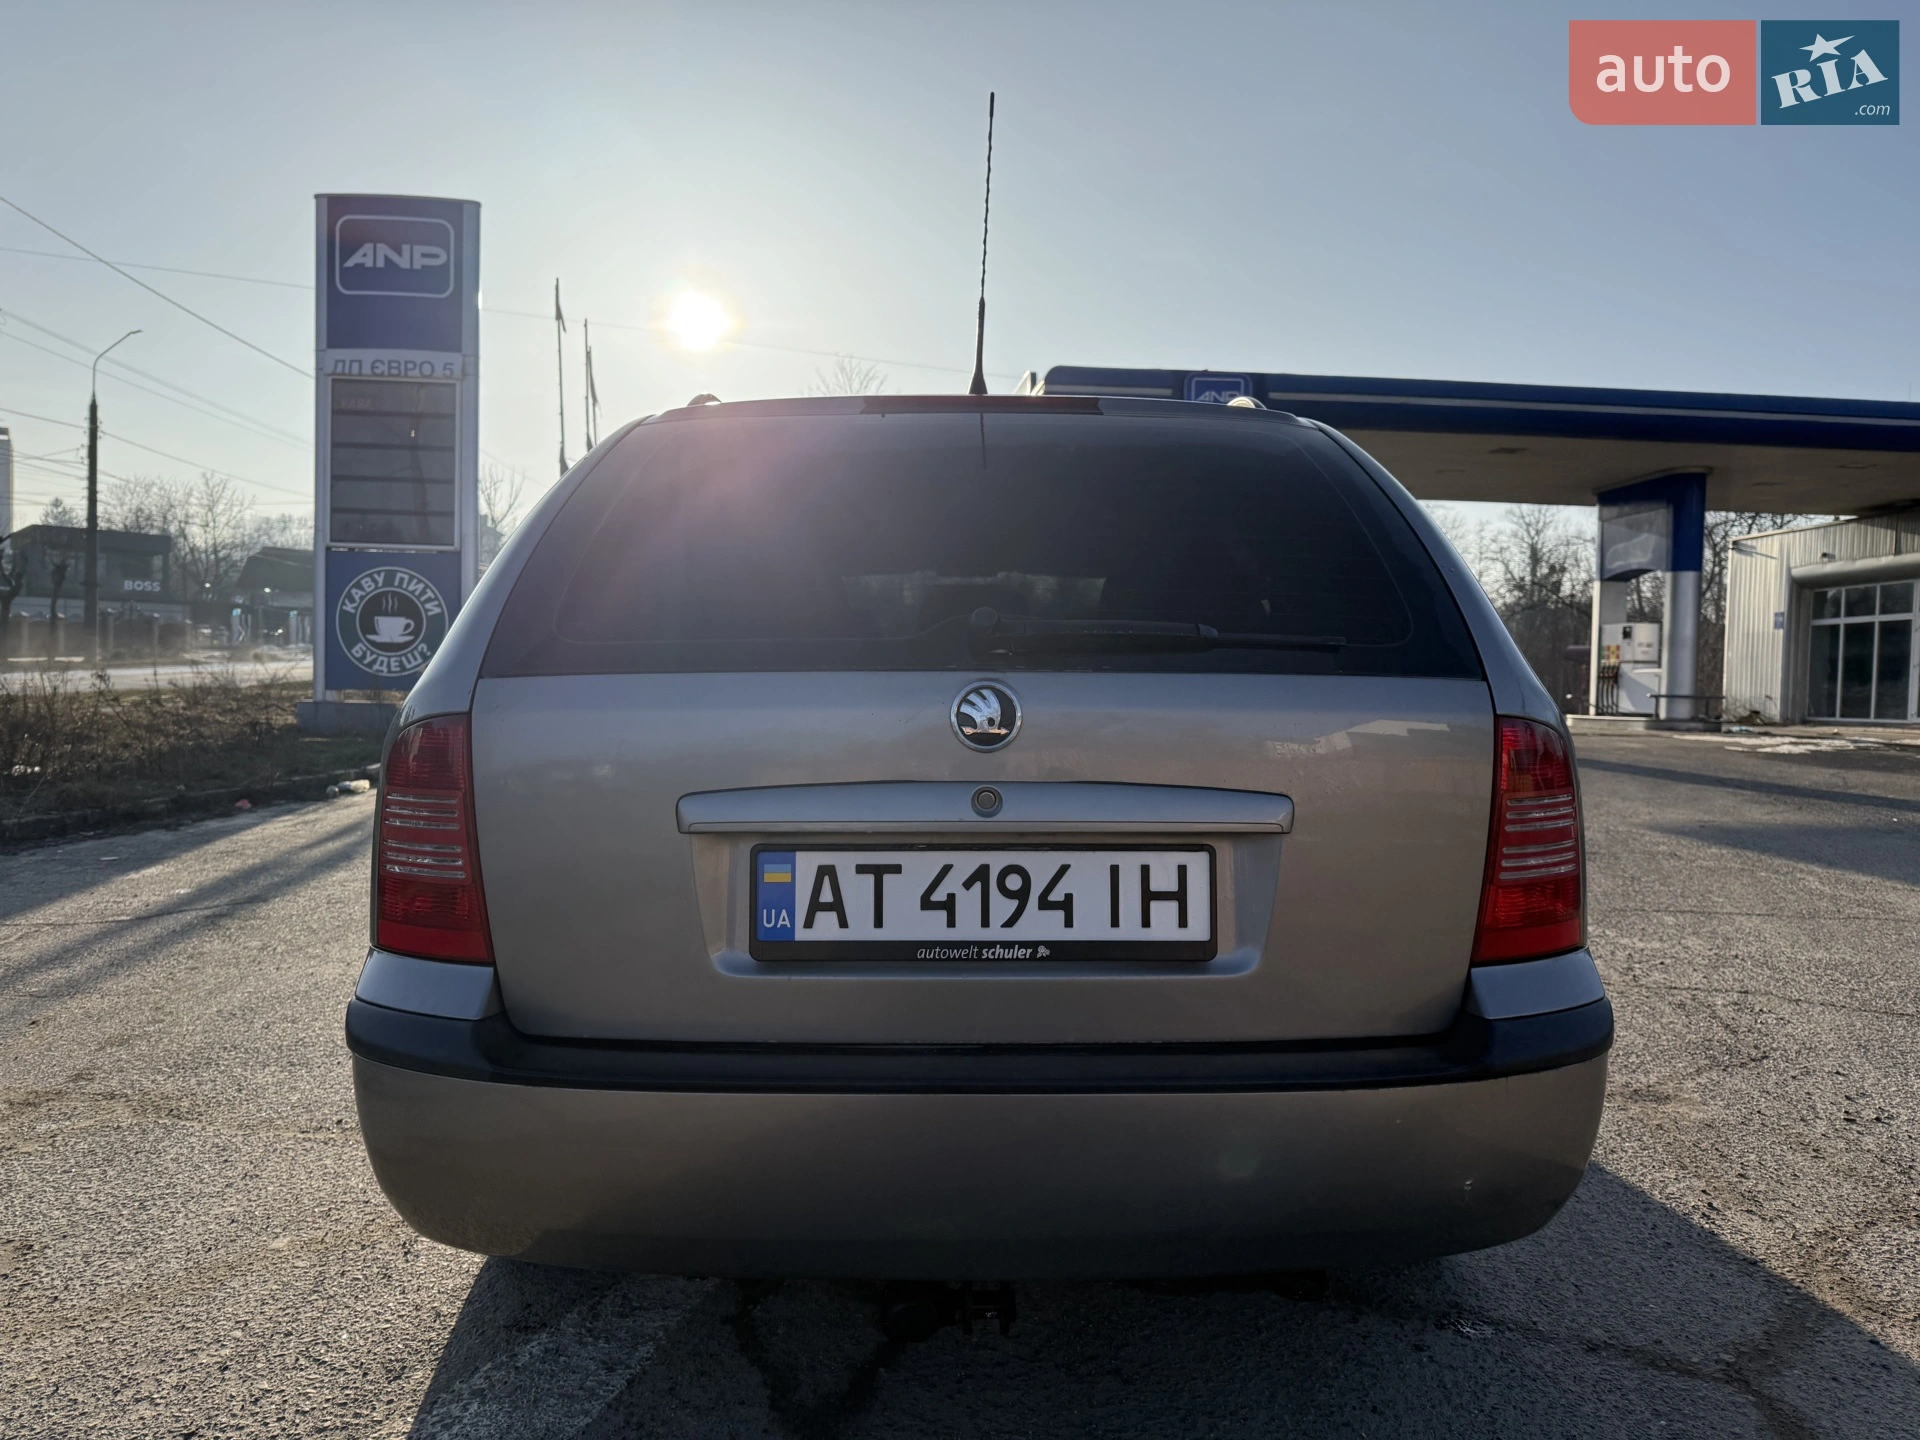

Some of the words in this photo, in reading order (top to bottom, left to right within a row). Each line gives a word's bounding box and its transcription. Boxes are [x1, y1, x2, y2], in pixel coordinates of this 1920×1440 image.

[343, 242, 448, 270] ANP
[370, 359, 435, 378] ЄВРО
[443, 362, 454, 378] 5
[124, 580, 161, 591] BOSS
[342, 571, 386, 614] КАВУ
[394, 571, 442, 616] ПИТИ
[351, 642, 431, 674] БУДЕШ?
[803, 864, 902, 928] AT
[920, 864, 1074, 928] 4194
[1109, 864, 1188, 928] IH
[762, 908, 791, 928] UA
[917, 945, 979, 959] autowelt
[981, 944, 1033, 959] schuler
